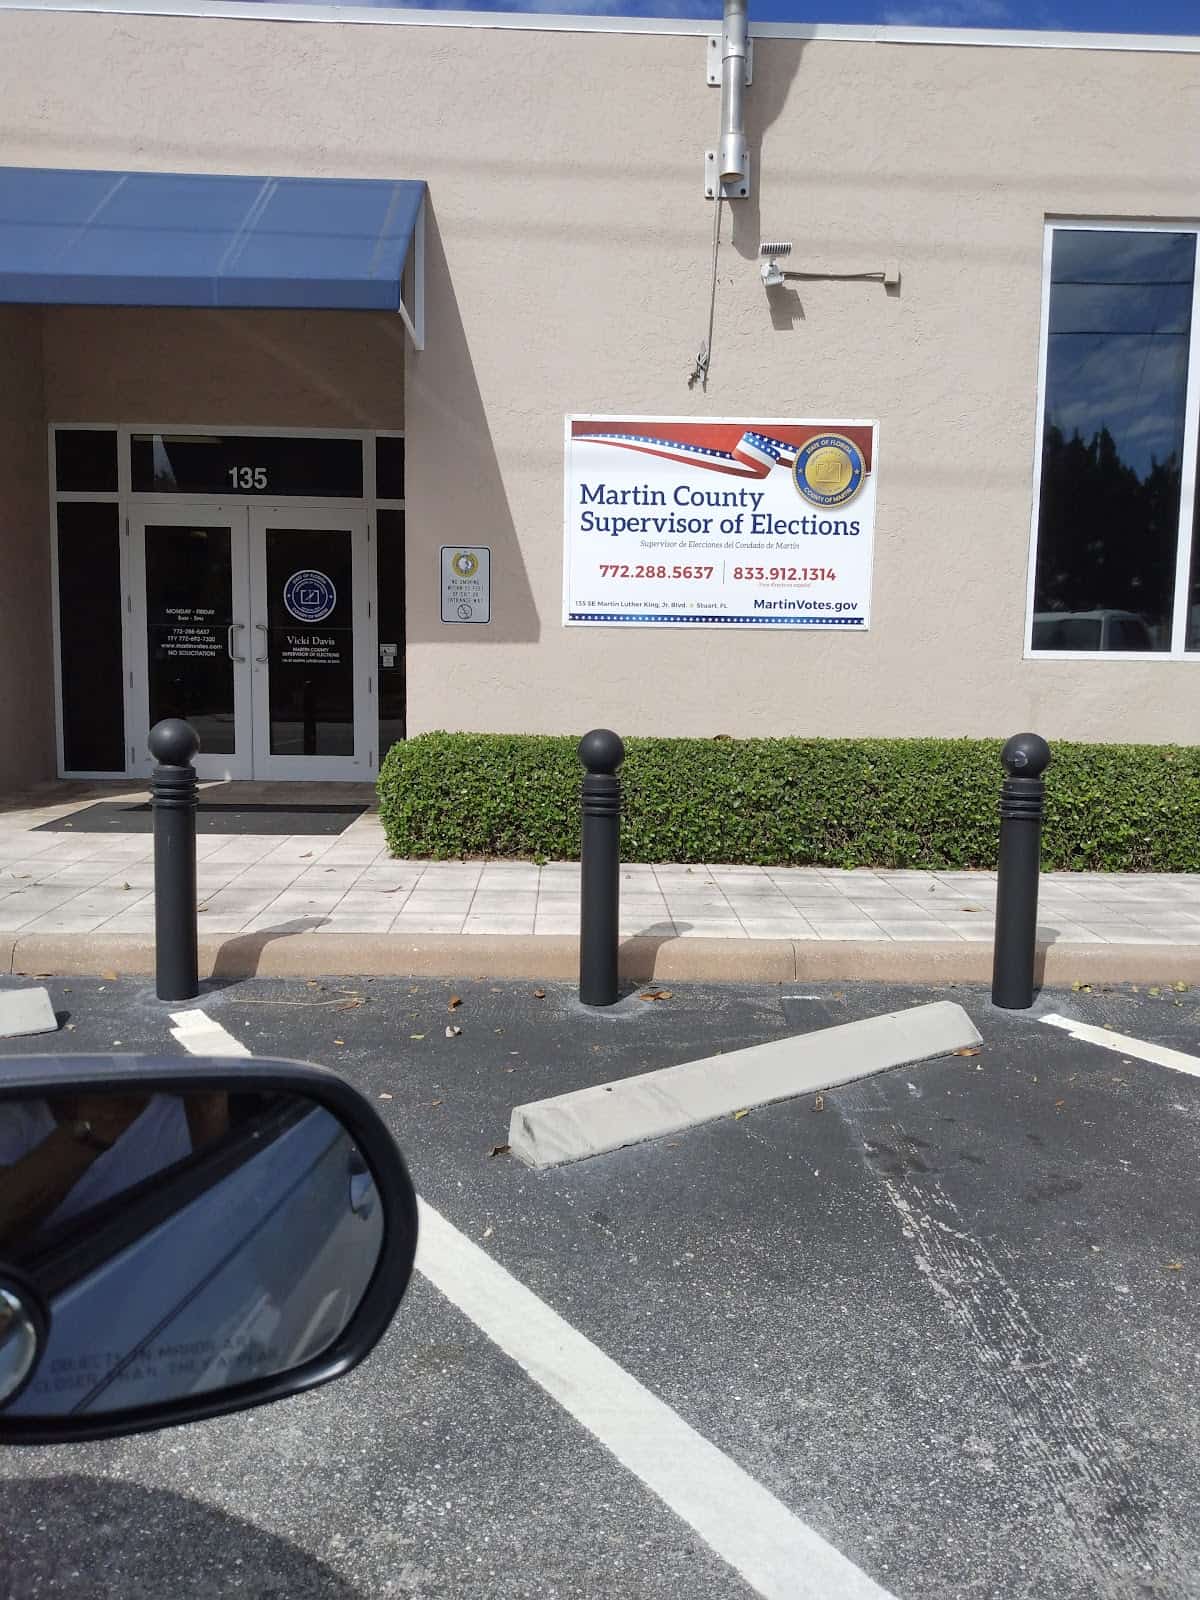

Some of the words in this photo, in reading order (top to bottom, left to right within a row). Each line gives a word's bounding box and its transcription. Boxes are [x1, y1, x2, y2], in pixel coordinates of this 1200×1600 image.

[229, 466, 268, 489] 135
[580, 484, 666, 506] Martin
[673, 485, 765, 511] County
[580, 511, 714, 536] Supervisor
[720, 513, 744, 534] of
[751, 514, 861, 536] Elections
[639, 539, 678, 549] Supervisor
[679, 540, 687, 548] de
[688, 540, 723, 549] Elecciones
[724, 540, 734, 549] del
[735, 541, 765, 550] Condado
[766, 541, 774, 550] de
[599, 565, 714, 579] 772.288.5637
[733, 567, 837, 582] 833.912.1314
[597, 600, 620, 608] Martin
[620, 600, 643, 608] Luther
[753, 598, 858, 613] MartinVotes.gov
[286, 635, 310, 645] Vicki
[312, 636, 336, 646] Davis
